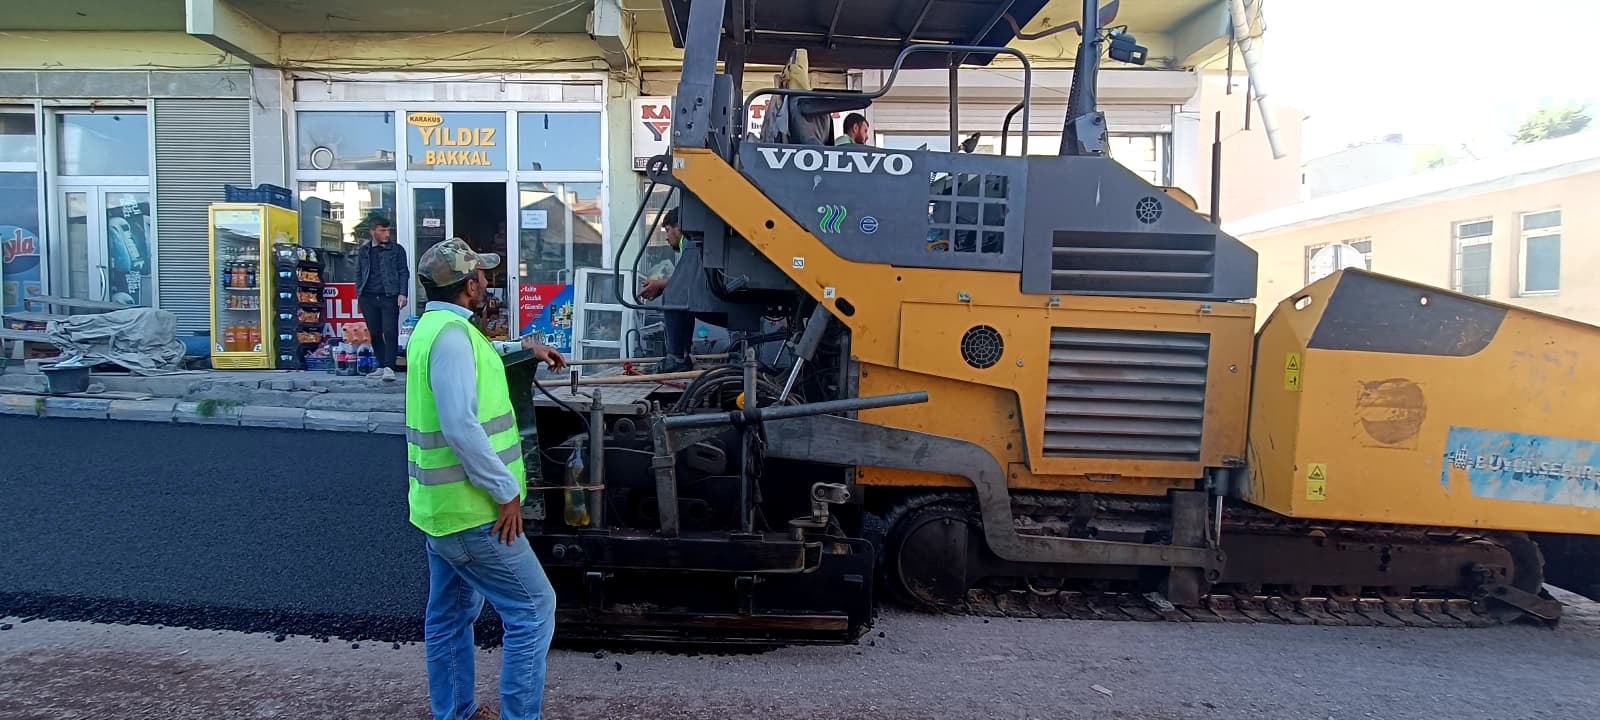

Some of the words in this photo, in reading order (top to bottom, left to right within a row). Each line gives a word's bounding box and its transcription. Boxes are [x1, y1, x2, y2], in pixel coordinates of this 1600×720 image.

[418, 126, 496, 147] YILDIZ
[425, 150, 492, 166] BAKKAL
[757, 147, 913, 176] VOLVO
